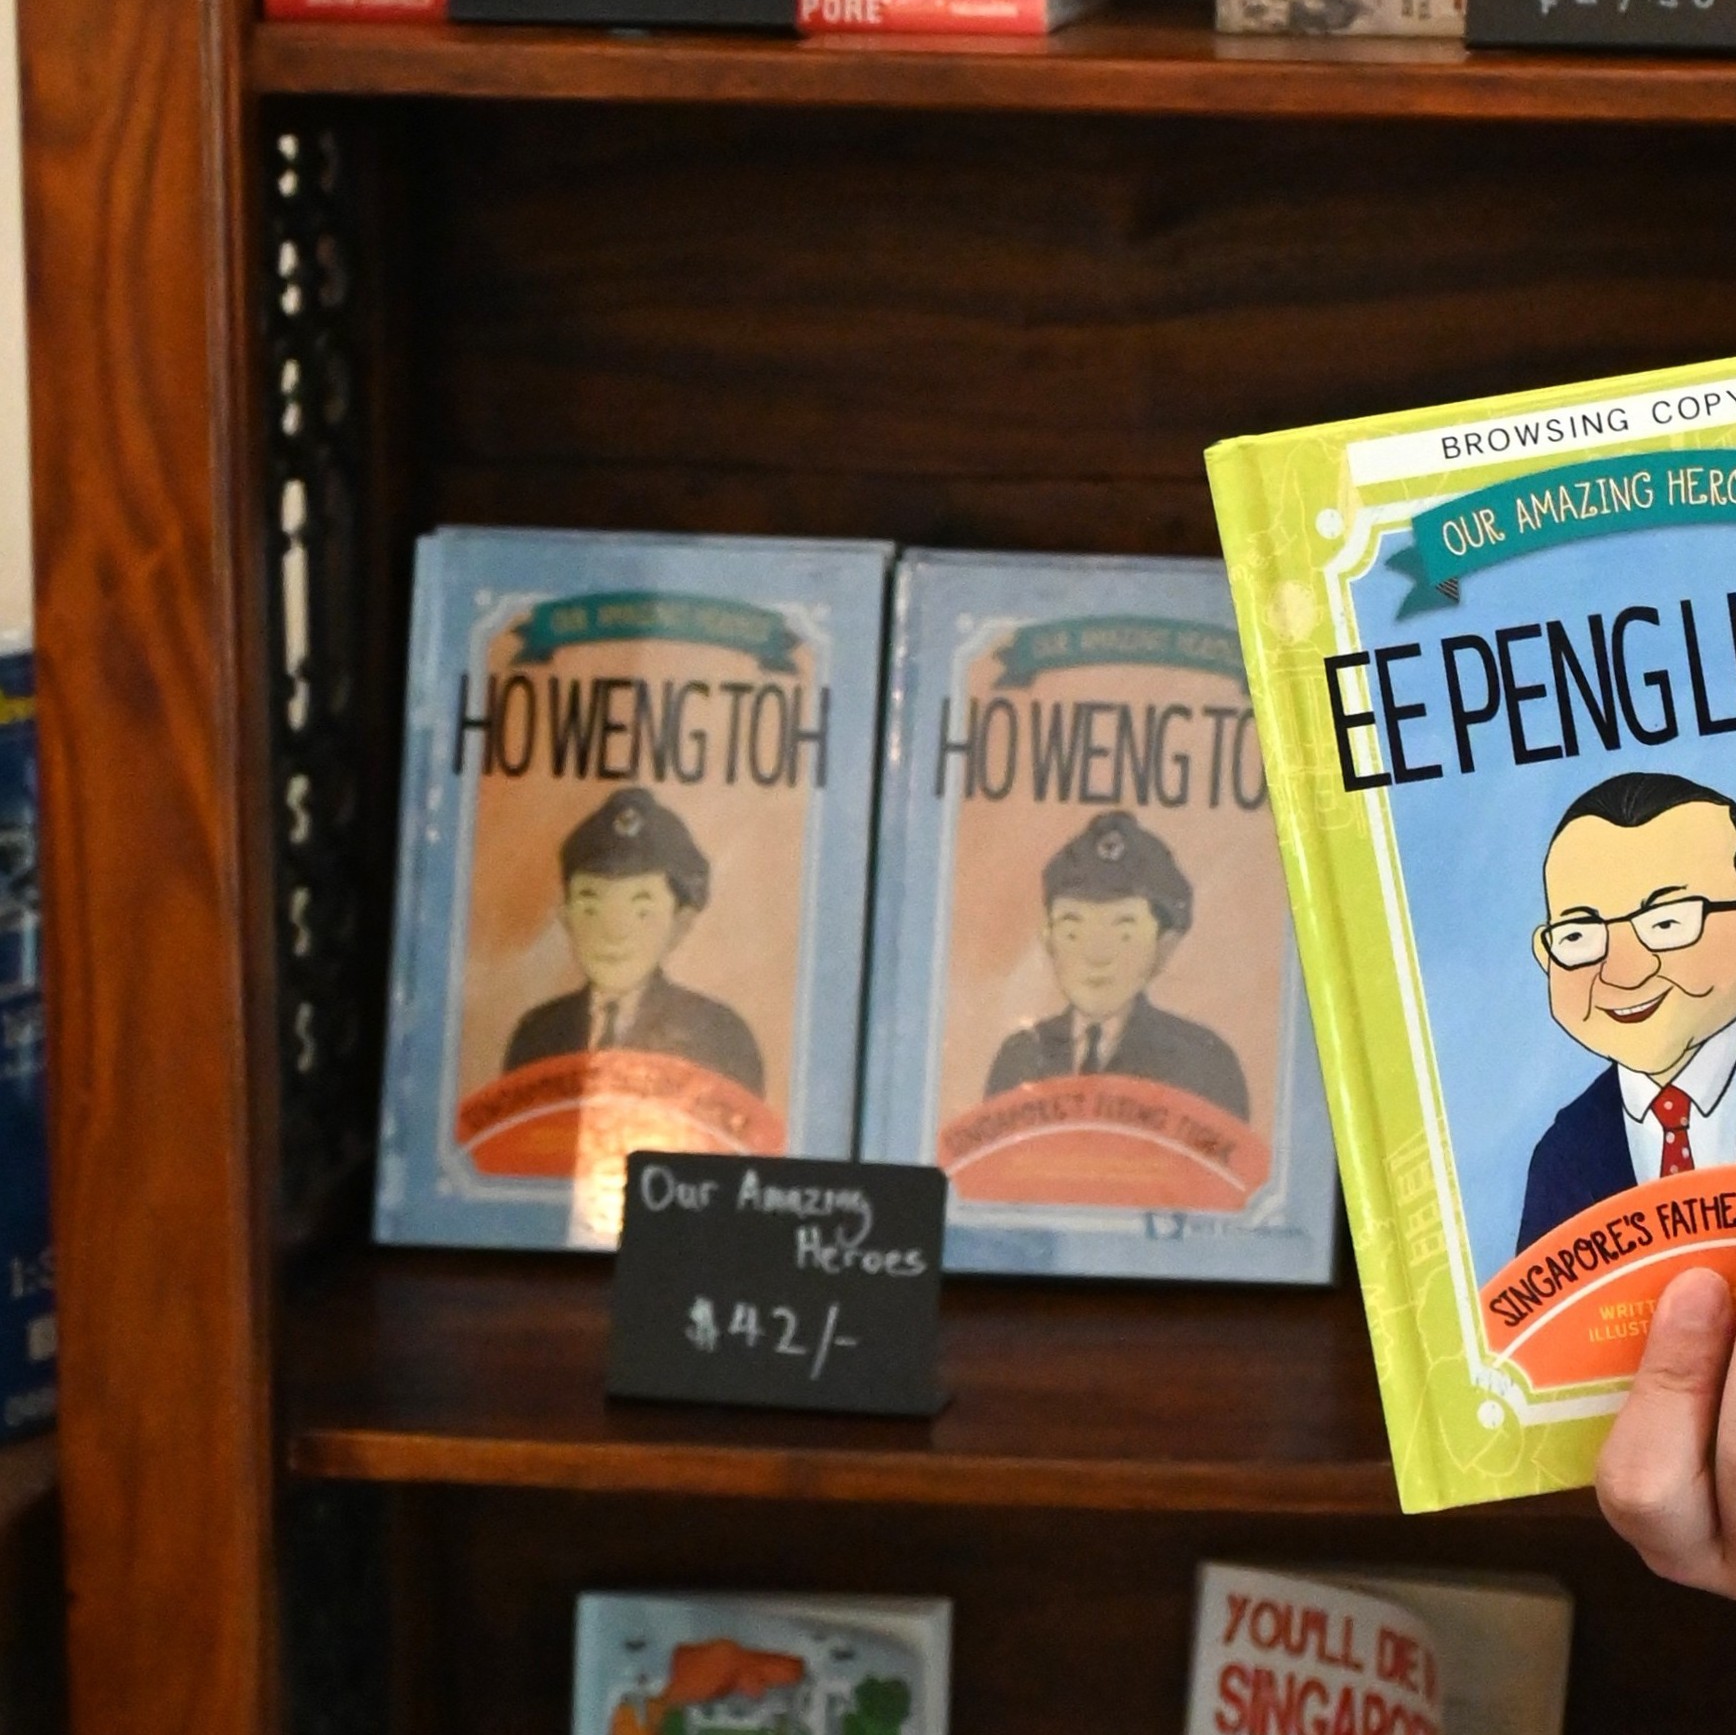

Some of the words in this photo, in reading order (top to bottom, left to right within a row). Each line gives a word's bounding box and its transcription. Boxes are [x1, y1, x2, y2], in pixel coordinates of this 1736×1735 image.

[1440, 407, 1630, 459] BROWSING
[1441, 508, 1506, 556] OUR
[1516, 470, 1655, 532] AMAZING
[451, 674, 537, 777] HO
[550, 676, 709, 784] WENG
[724, 682, 831, 790] TOH
[1323, 643, 1443, 792] EE
[1441, 605, 1679, 774] PENG
[934, 696, 1018, 801] HO
[1031, 700, 1191, 809] WENG
[640, 1165, 718, 1212] Our
[796, 1225, 927, 1277] Heroes
[1488, 1208, 1654, 1329] SINGAPORE'S
[1221, 1592, 1364, 1675] YOU'LL
